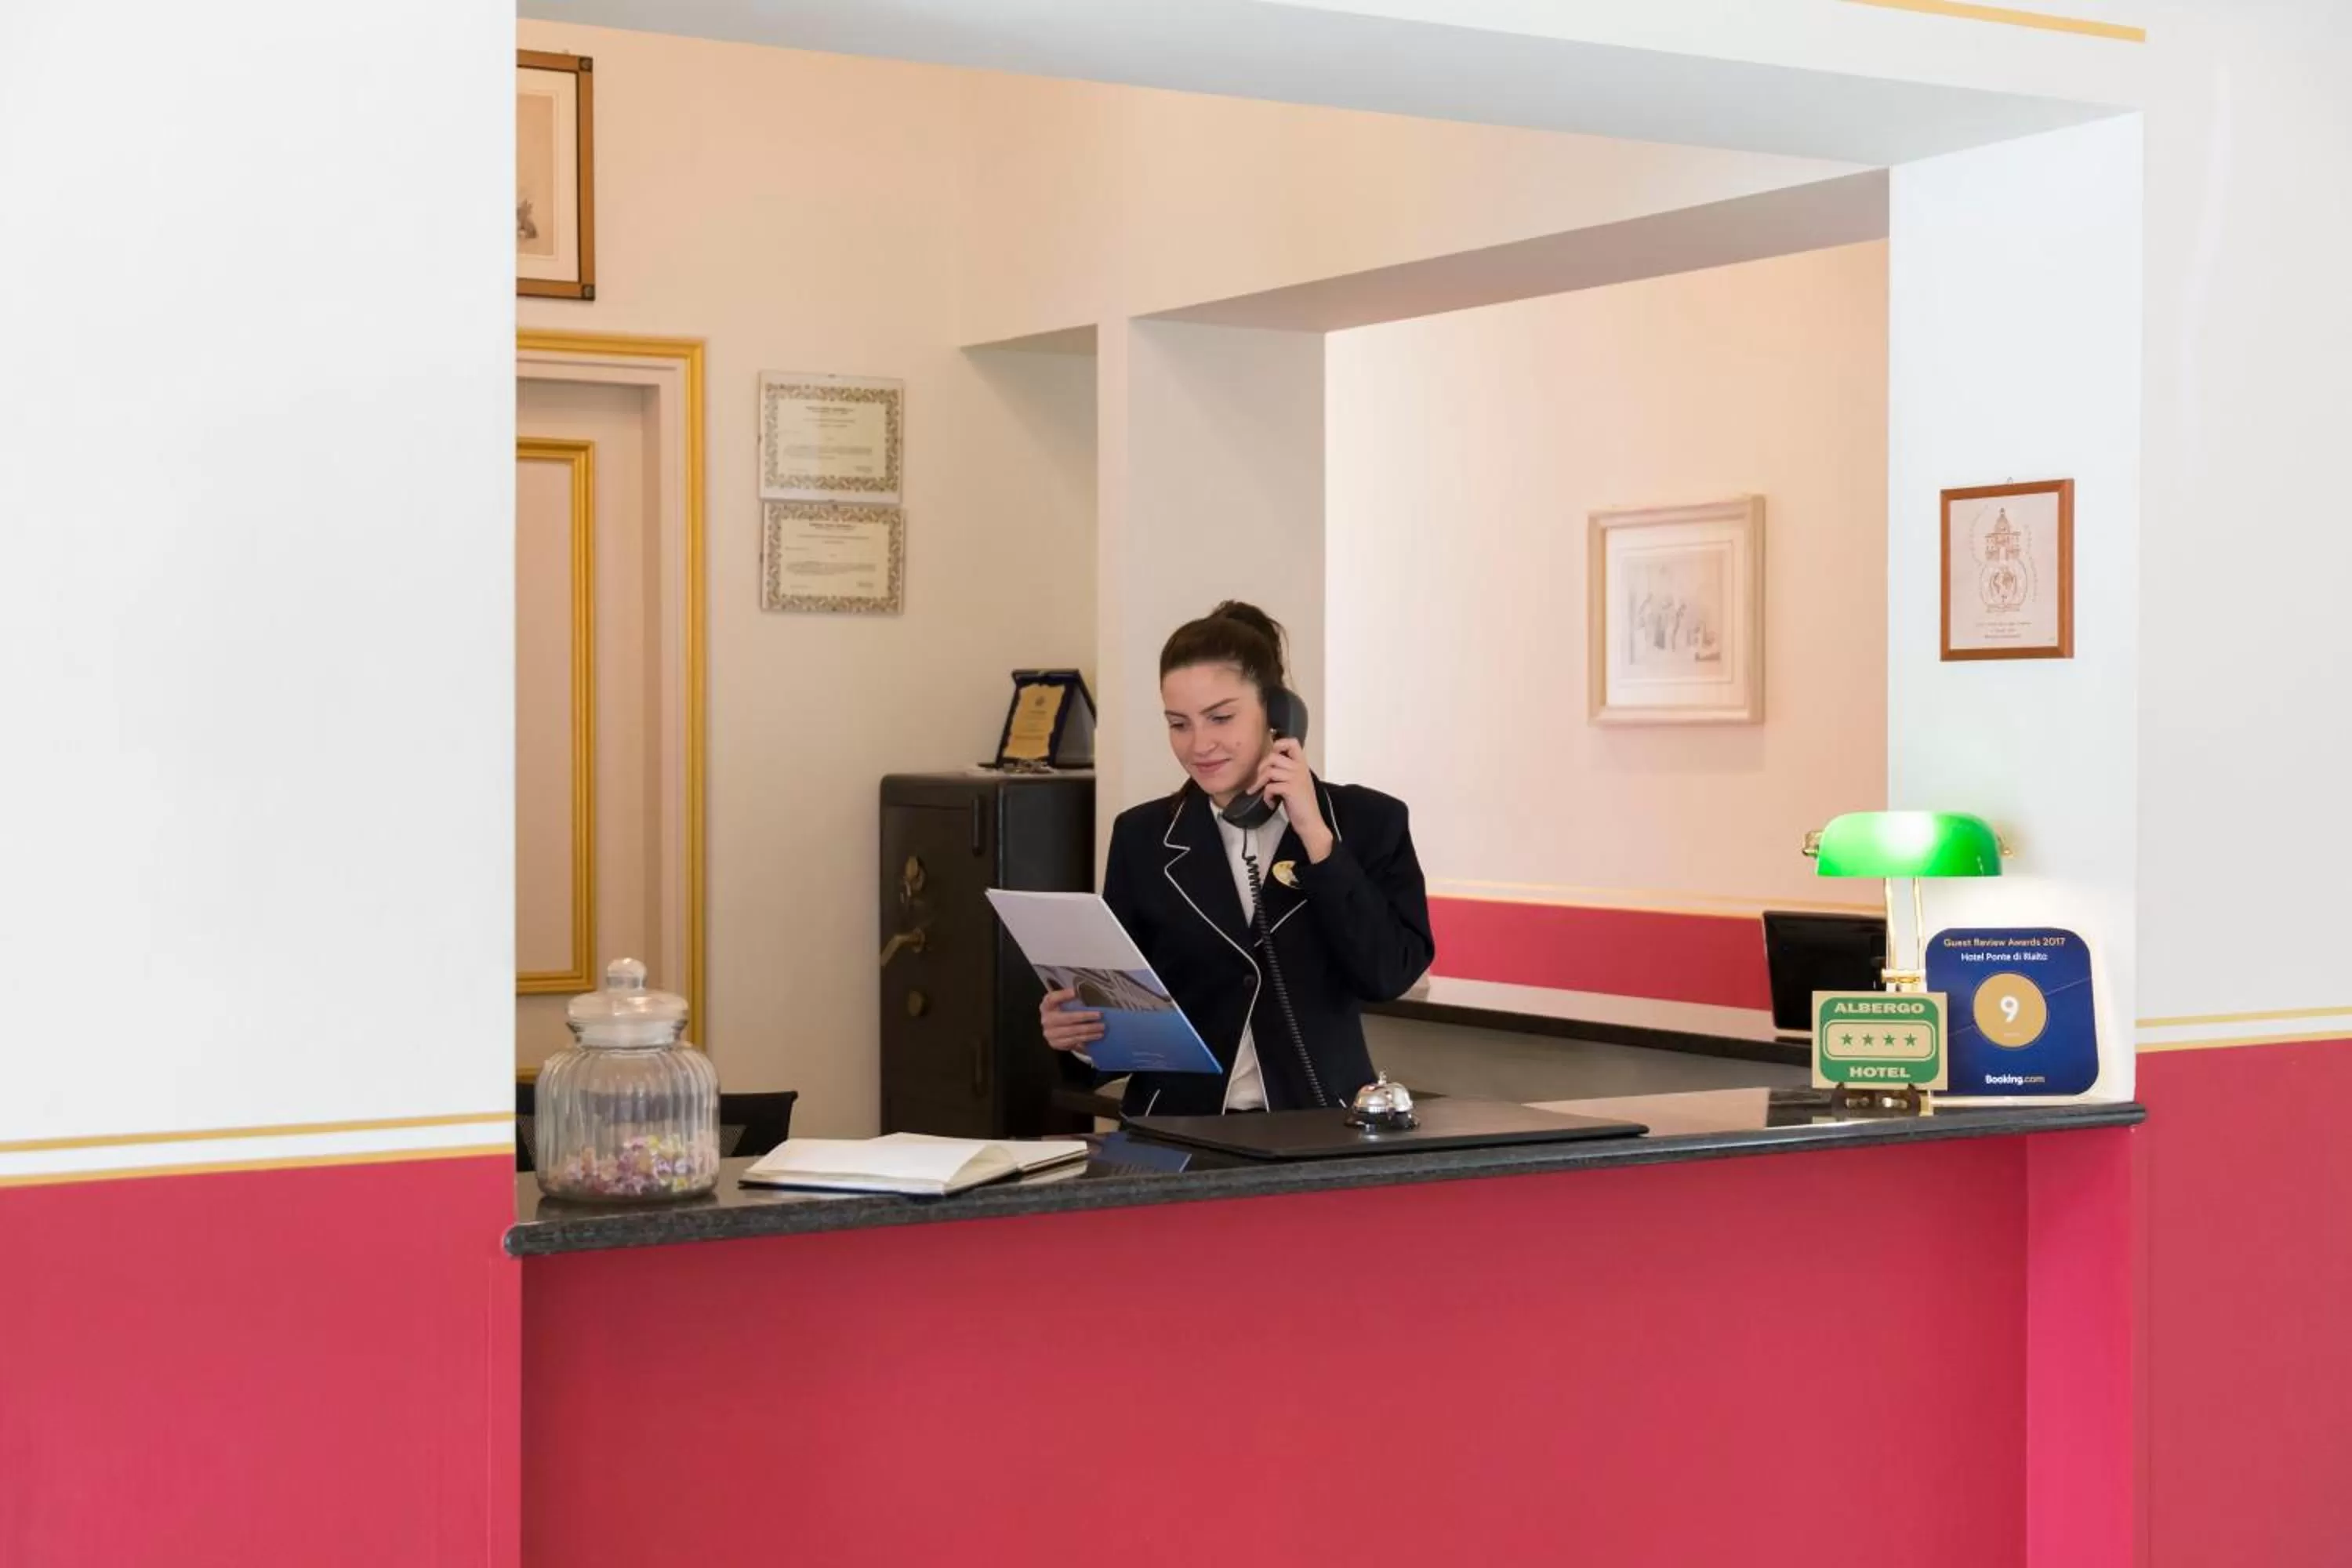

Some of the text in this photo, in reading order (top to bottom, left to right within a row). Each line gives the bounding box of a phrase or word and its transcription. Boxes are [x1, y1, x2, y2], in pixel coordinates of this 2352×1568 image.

[1944, 937, 2066, 947] Guest Review Awards 2017
[1961, 951, 2048, 961] Hotel Ponte di Rialto
[1834, 1002, 1925, 1014] ALBERGO
[2000, 995, 2020, 1023] 9
[1849, 1066, 1911, 1078] HOTEL
[1985, 1074, 2045, 1085] Booking.com
